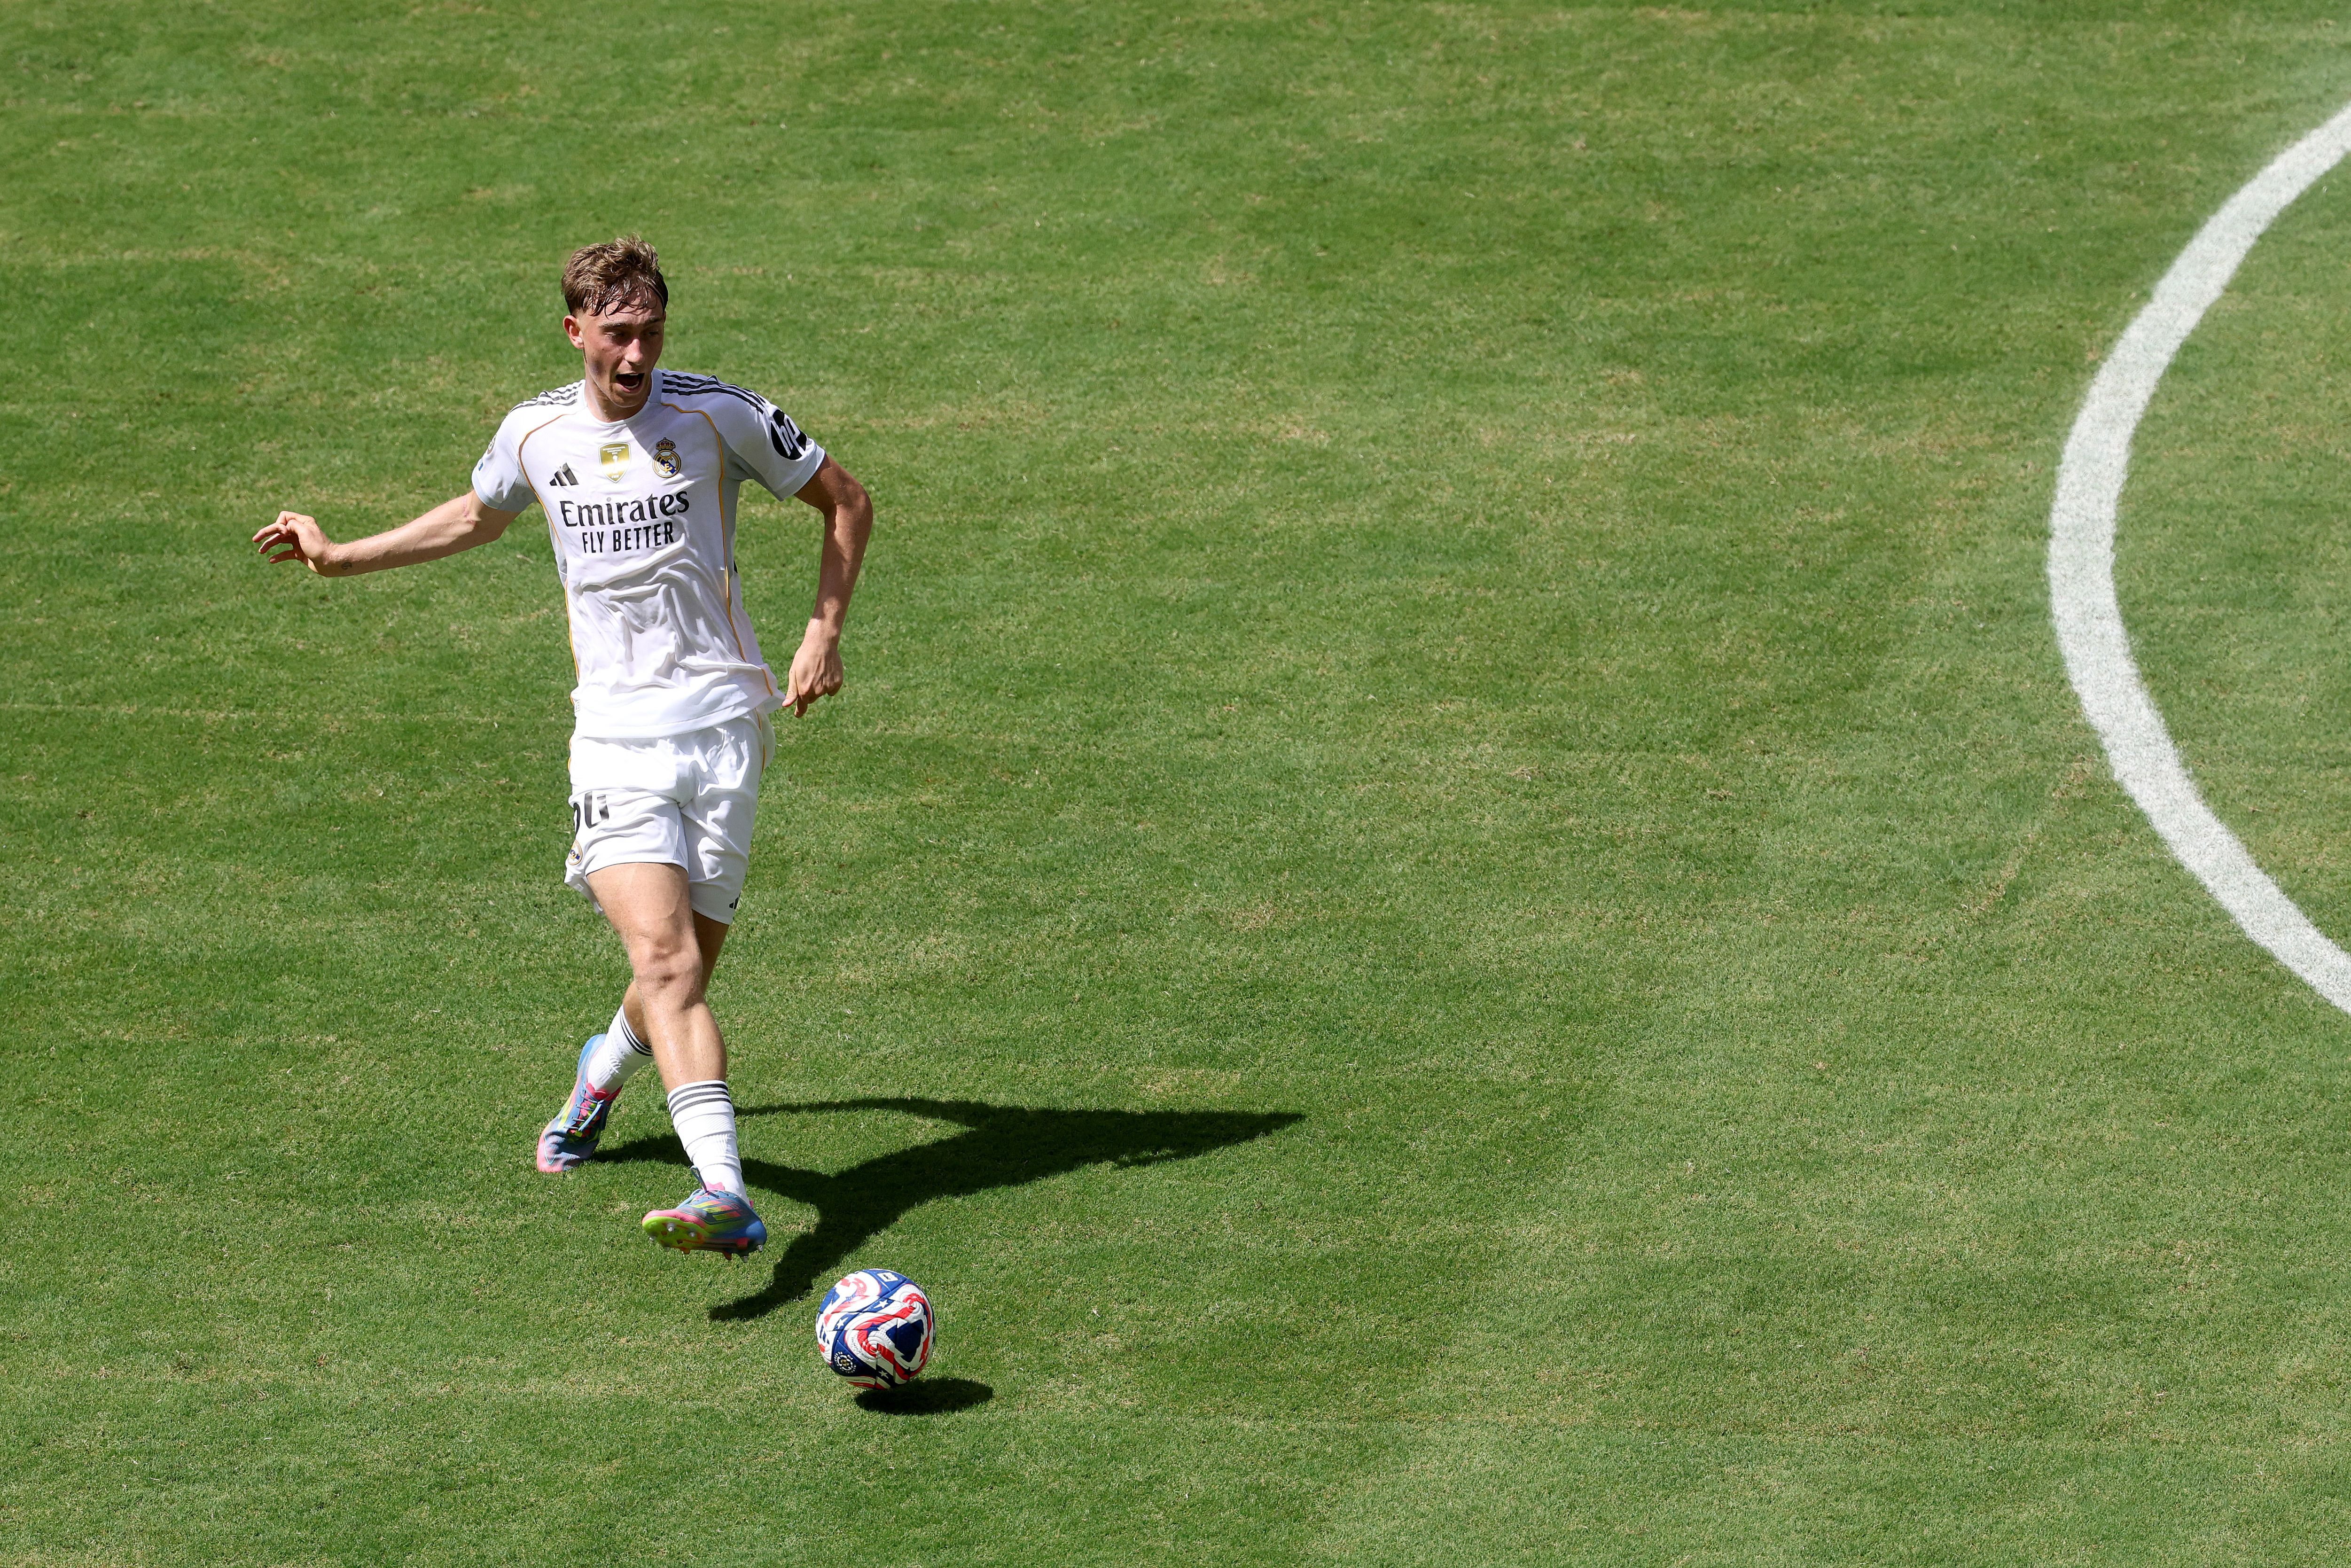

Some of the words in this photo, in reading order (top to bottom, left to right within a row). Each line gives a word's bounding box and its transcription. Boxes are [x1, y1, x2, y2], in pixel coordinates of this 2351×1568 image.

[771, 412, 804, 458] hp
[560, 491, 689, 527] Emirates
[582, 531, 604, 553] FLY
[613, 522, 674, 552] BETTER
